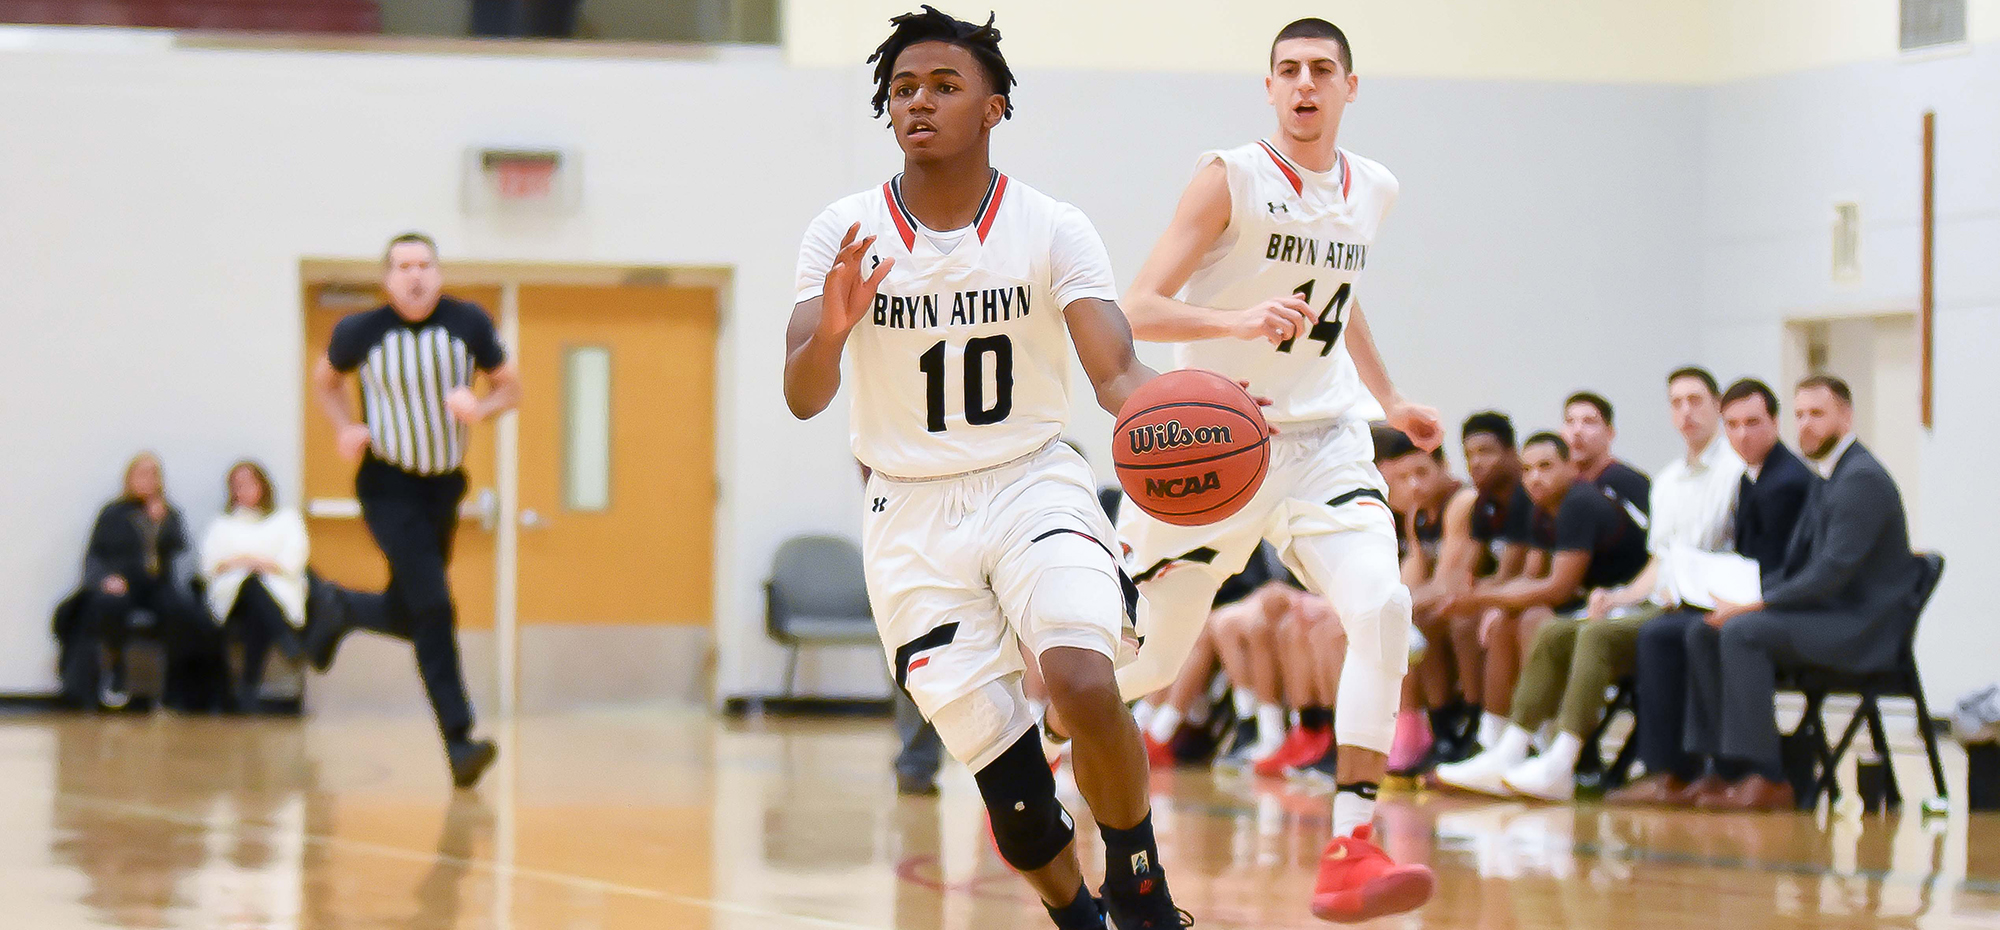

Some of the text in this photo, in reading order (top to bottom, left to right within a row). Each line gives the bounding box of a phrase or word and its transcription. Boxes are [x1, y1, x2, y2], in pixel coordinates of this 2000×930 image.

[1265, 232, 1369, 271] BRYN ATHYN
[873, 284, 1031, 329] BRYN ATHYN
[918, 333, 1014, 433] 10
[1127, 418, 1235, 456] Wilson
[1145, 470, 1222, 498] NCAA
